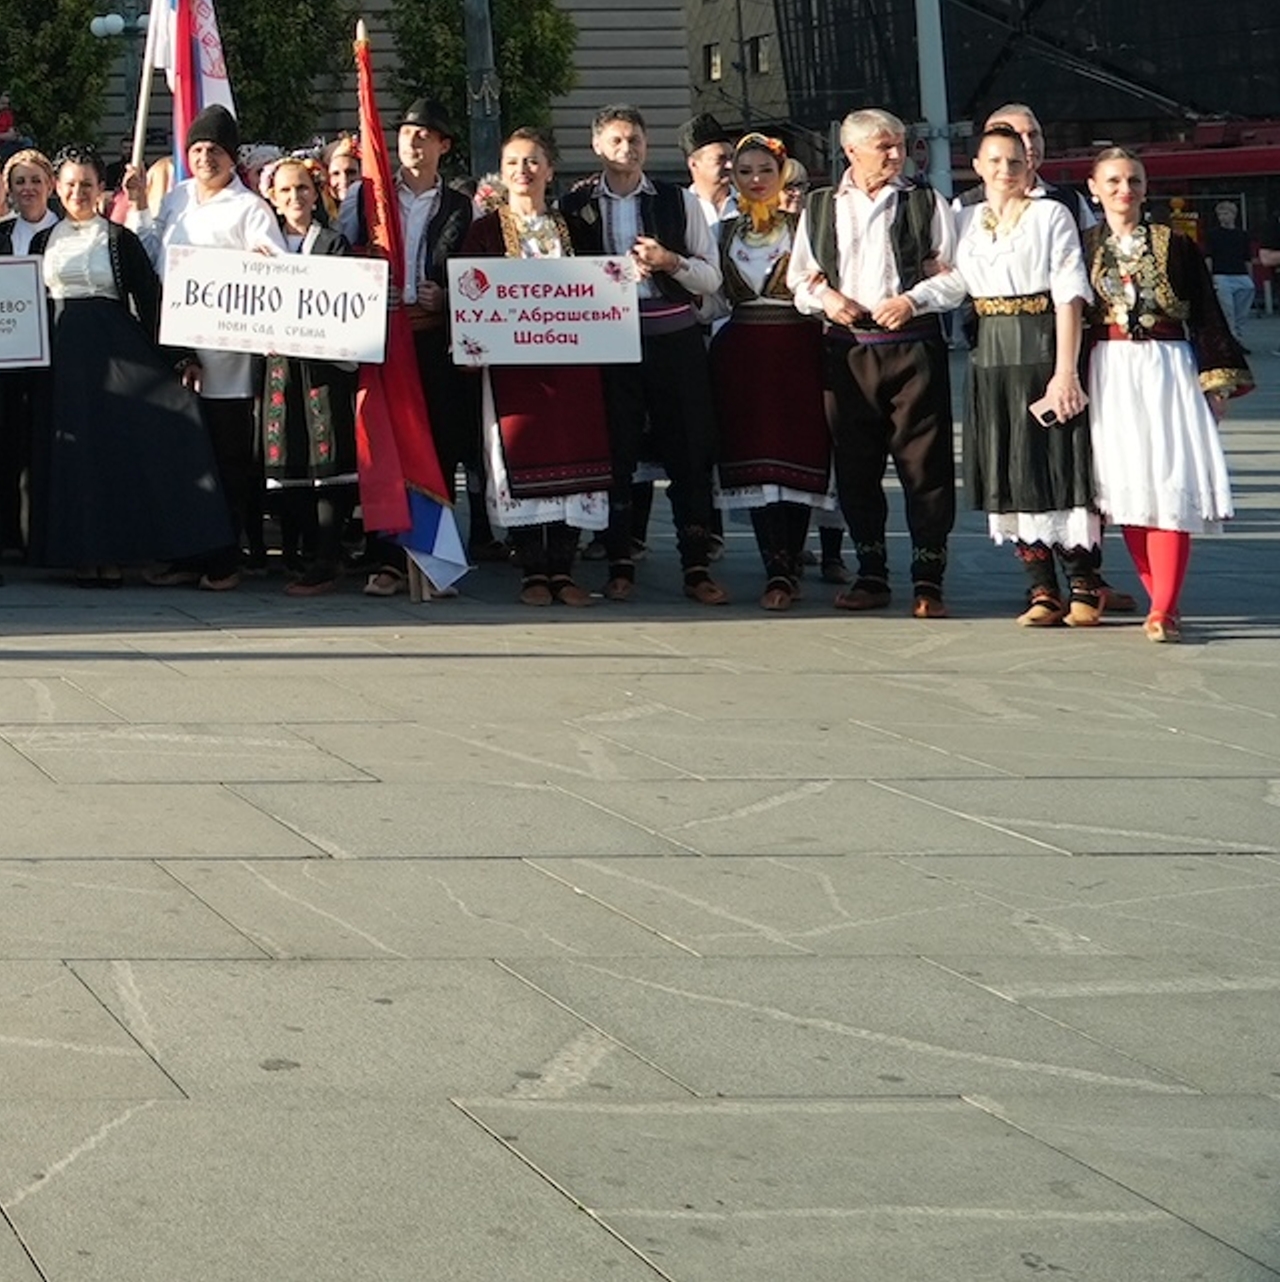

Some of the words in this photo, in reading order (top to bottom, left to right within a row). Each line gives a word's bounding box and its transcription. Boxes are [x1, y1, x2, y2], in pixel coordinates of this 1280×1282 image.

[218, 320, 248, 332] НОВИ
[252, 322, 275, 335] САД
[285, 325, 327, 339] СРБИЈА
[514, 330, 579, 346] Шабац
